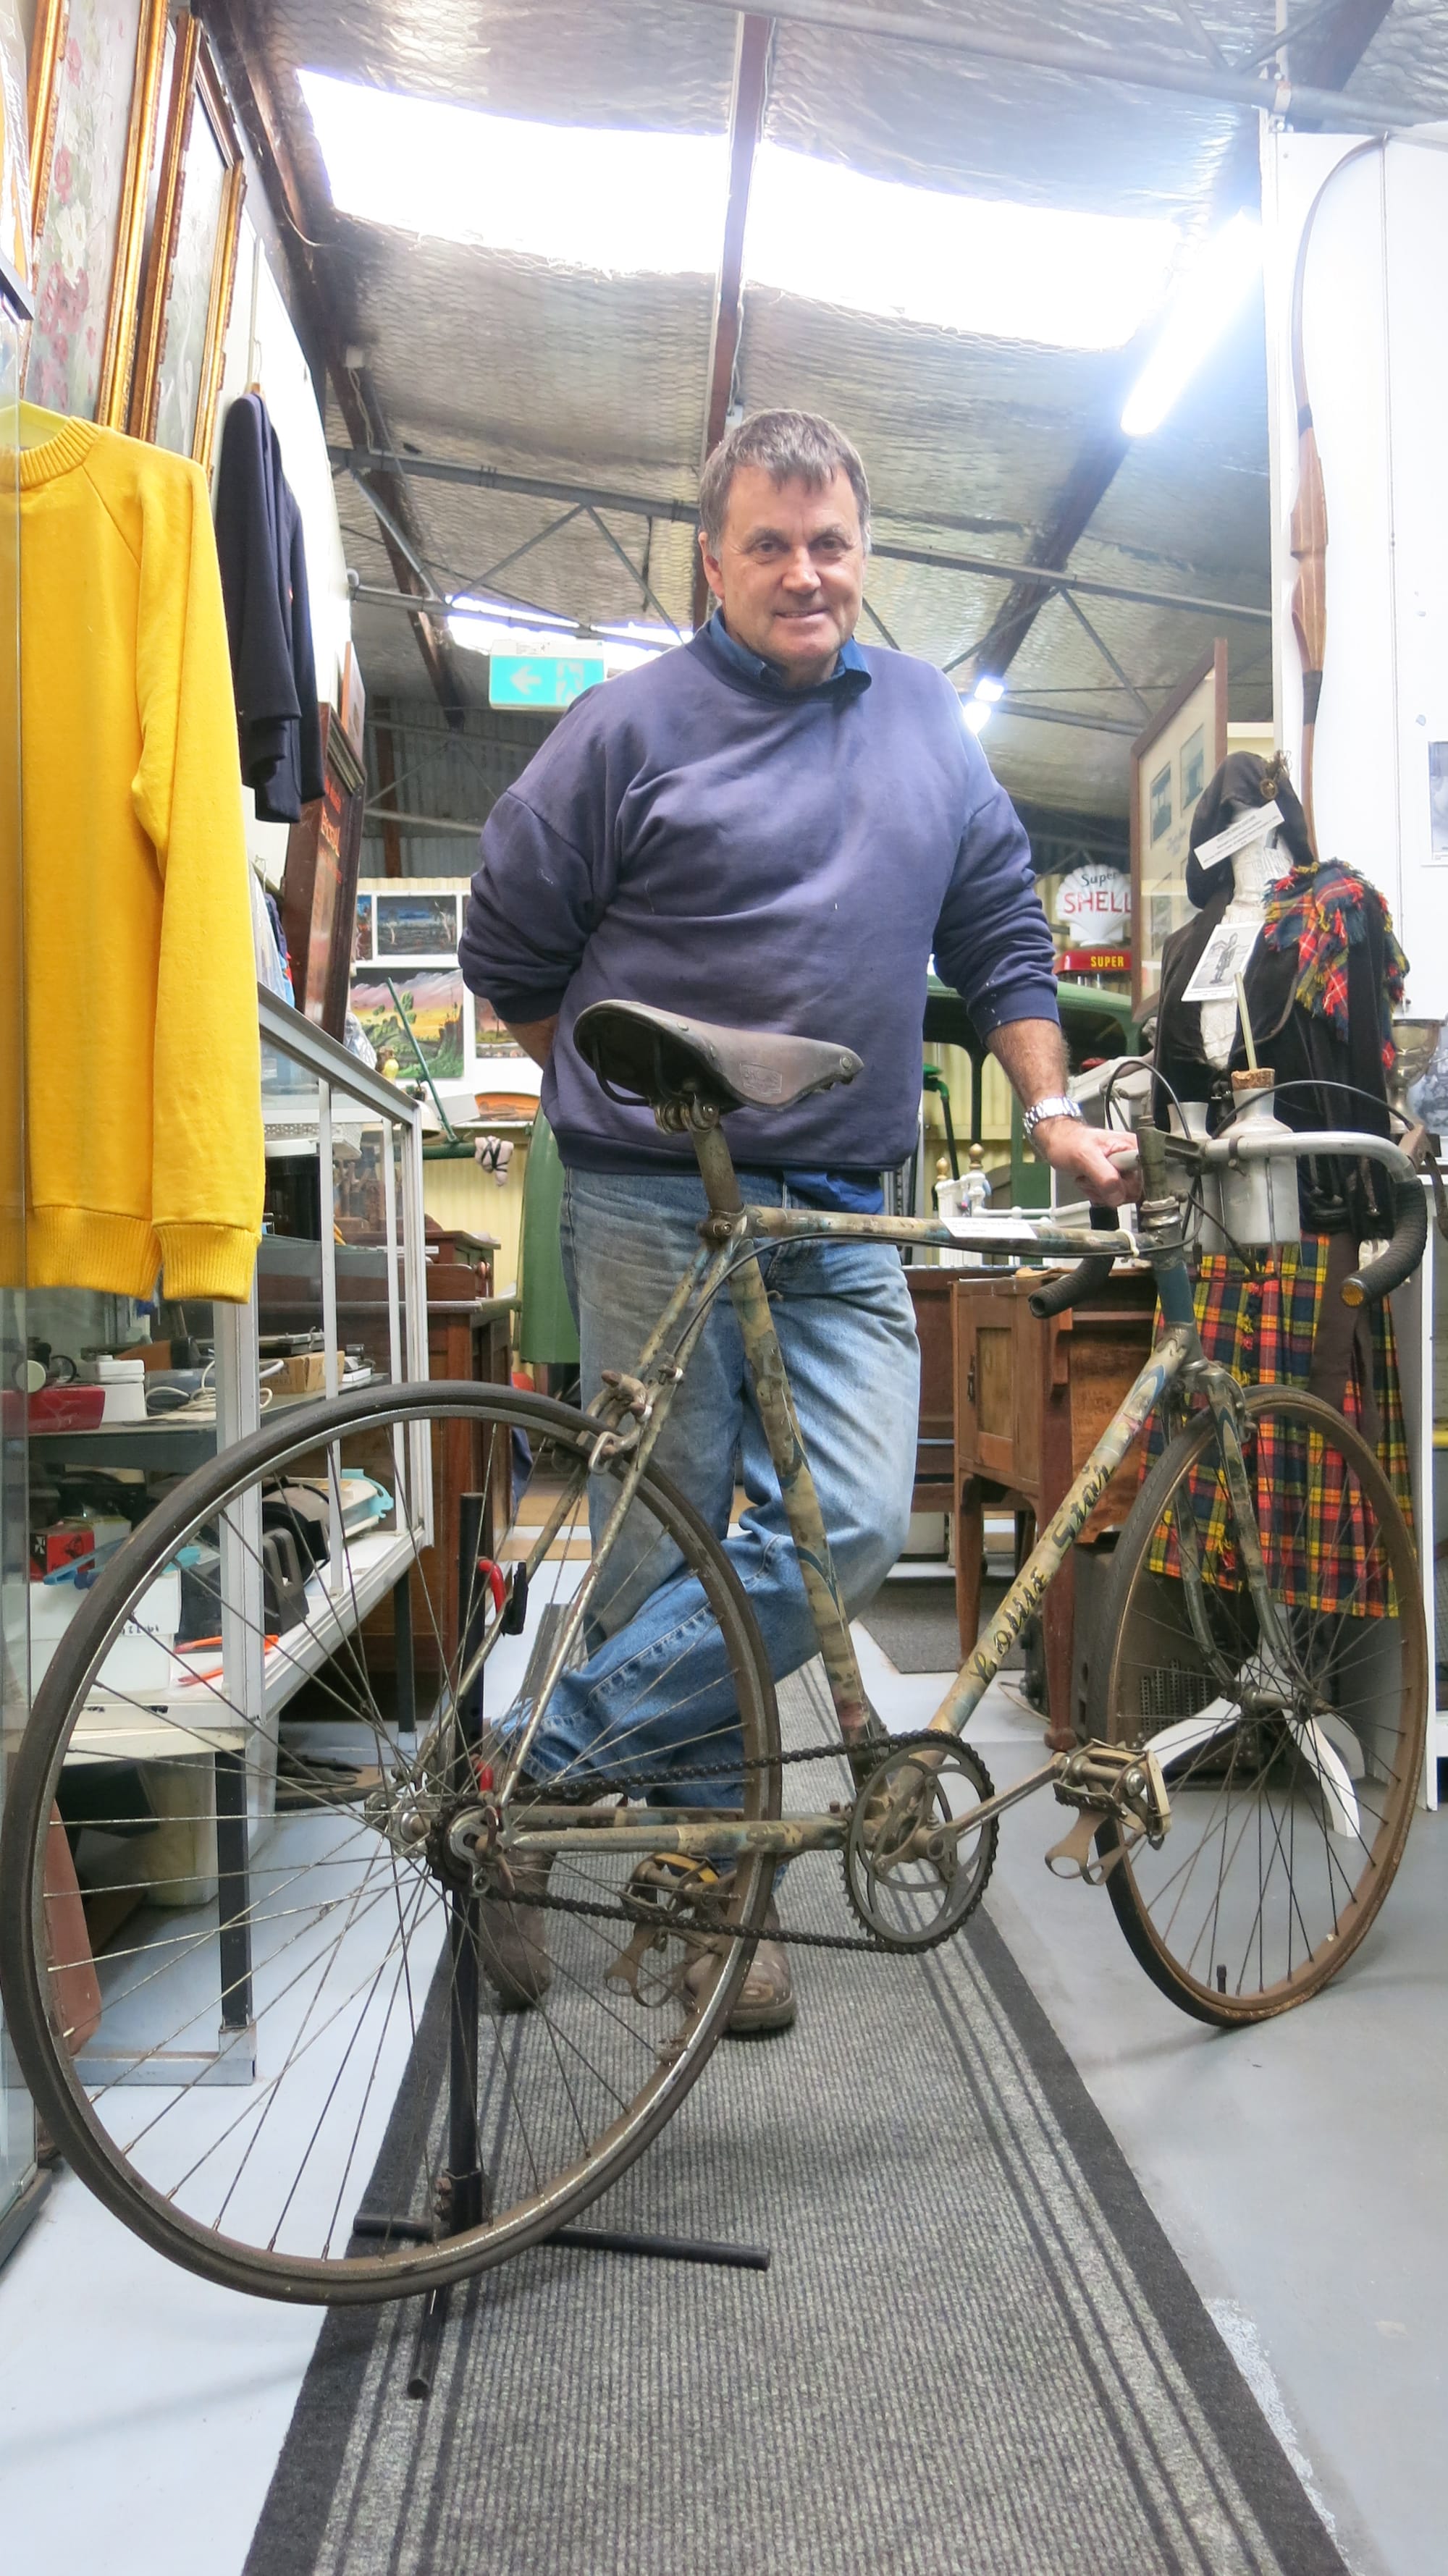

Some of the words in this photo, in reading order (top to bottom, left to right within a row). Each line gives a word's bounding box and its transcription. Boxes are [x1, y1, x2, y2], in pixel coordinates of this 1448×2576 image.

[1081, 871, 1119, 887] Super
[1064, 891, 1132, 913] SHELL
[1090, 955, 1124, 967] SUPER
[1051, 1464, 1116, 1554] Star
